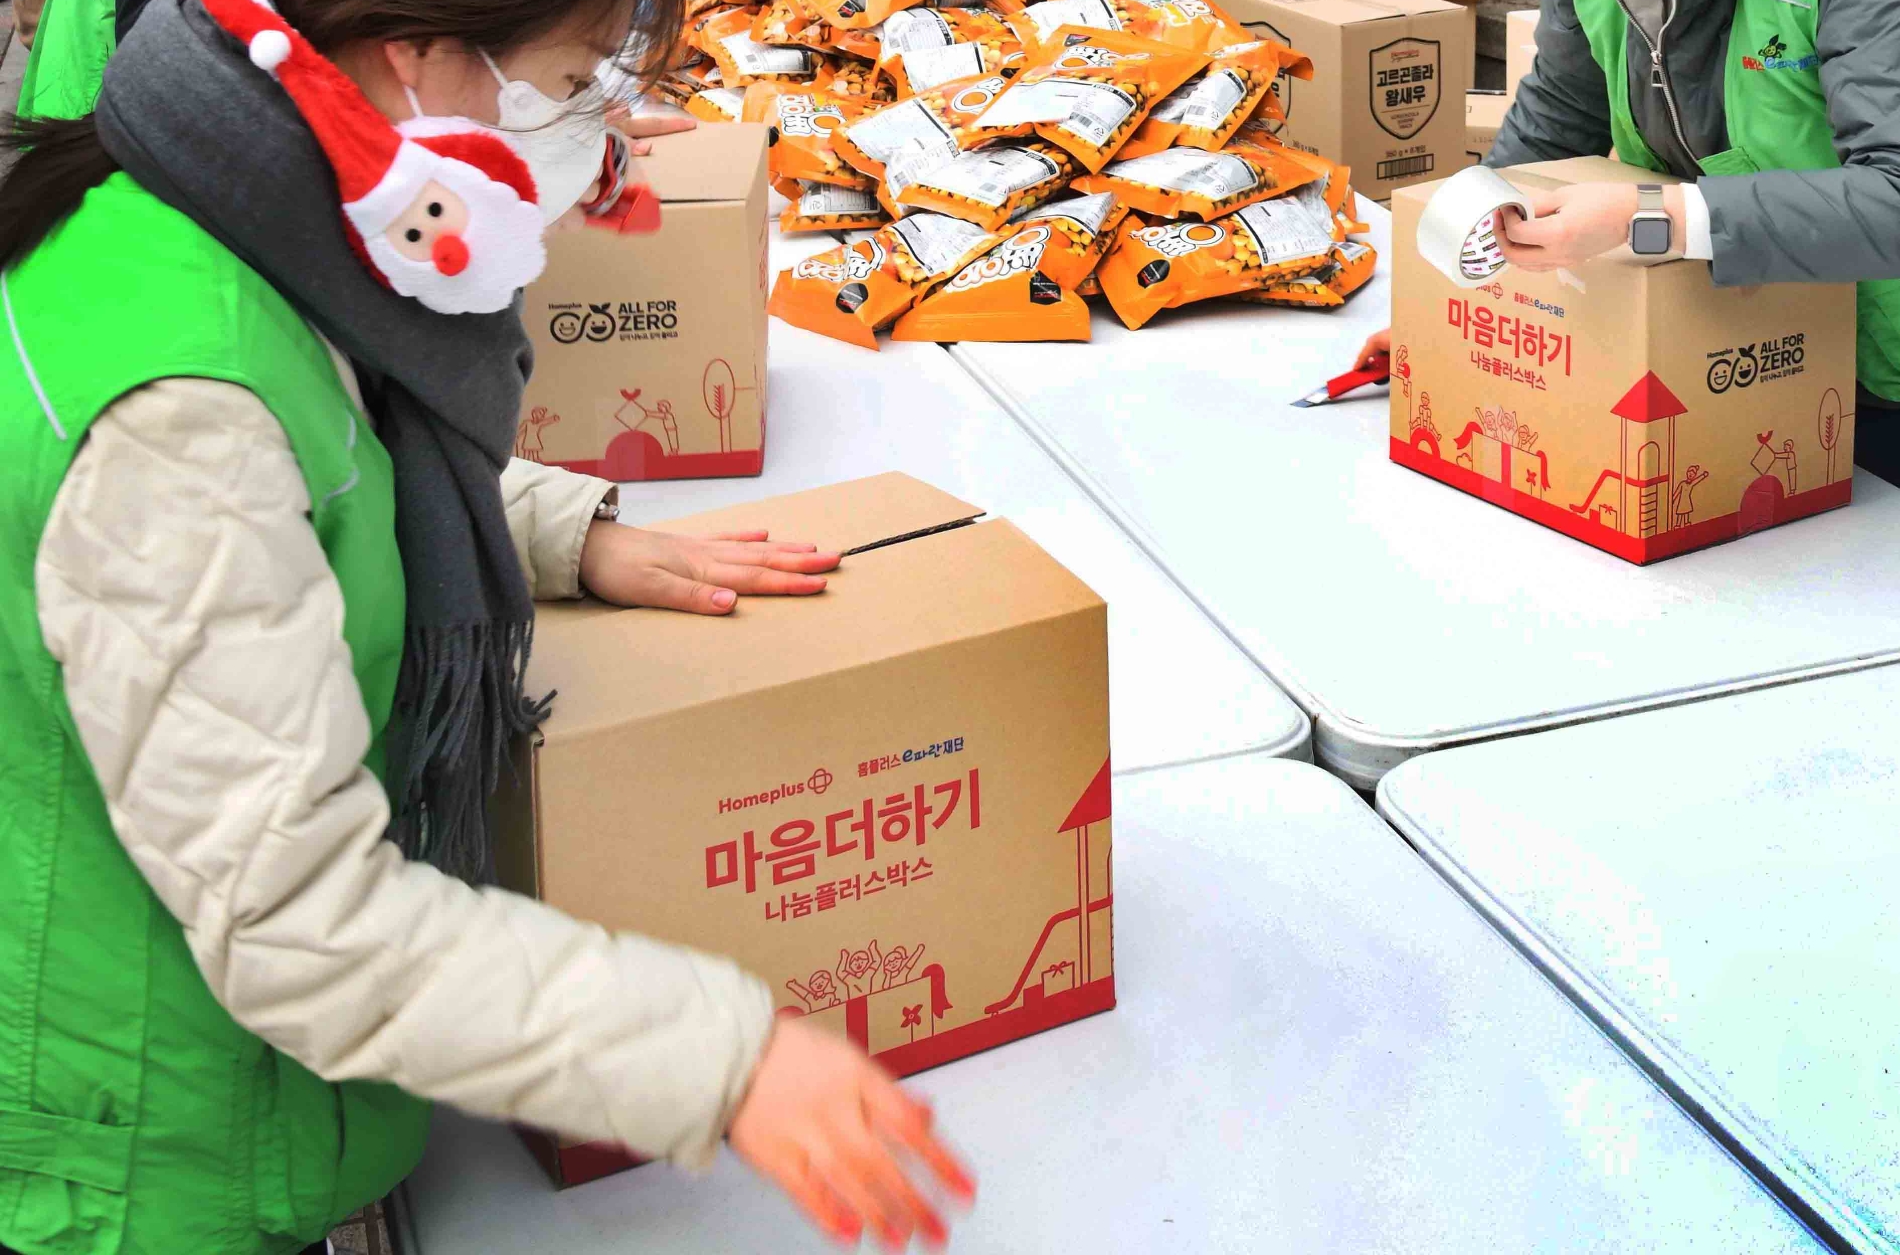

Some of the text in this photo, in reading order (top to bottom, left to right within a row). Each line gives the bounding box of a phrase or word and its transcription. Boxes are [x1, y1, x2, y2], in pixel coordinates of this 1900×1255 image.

[1377, 64, 1433, 87] 고르곤졸라
[1386, 85, 1425, 107] 왕새우
[618, 300, 677, 314] ALL FOR
[618, 313, 678, 331] ZERO
[1448, 297, 1571, 376] 마음더하기
[1760, 333, 1804, 354] ALL FOR
[1707, 348, 1733, 358] Homeplus
[1760, 346, 1804, 373] ZERO
[1470, 350, 1547, 391] 나눔플러스박스
[718, 782, 805, 814] Homeplus
[705, 768, 981, 894] 마음더하기
[765, 856, 933, 922] 나눔플러스박스
